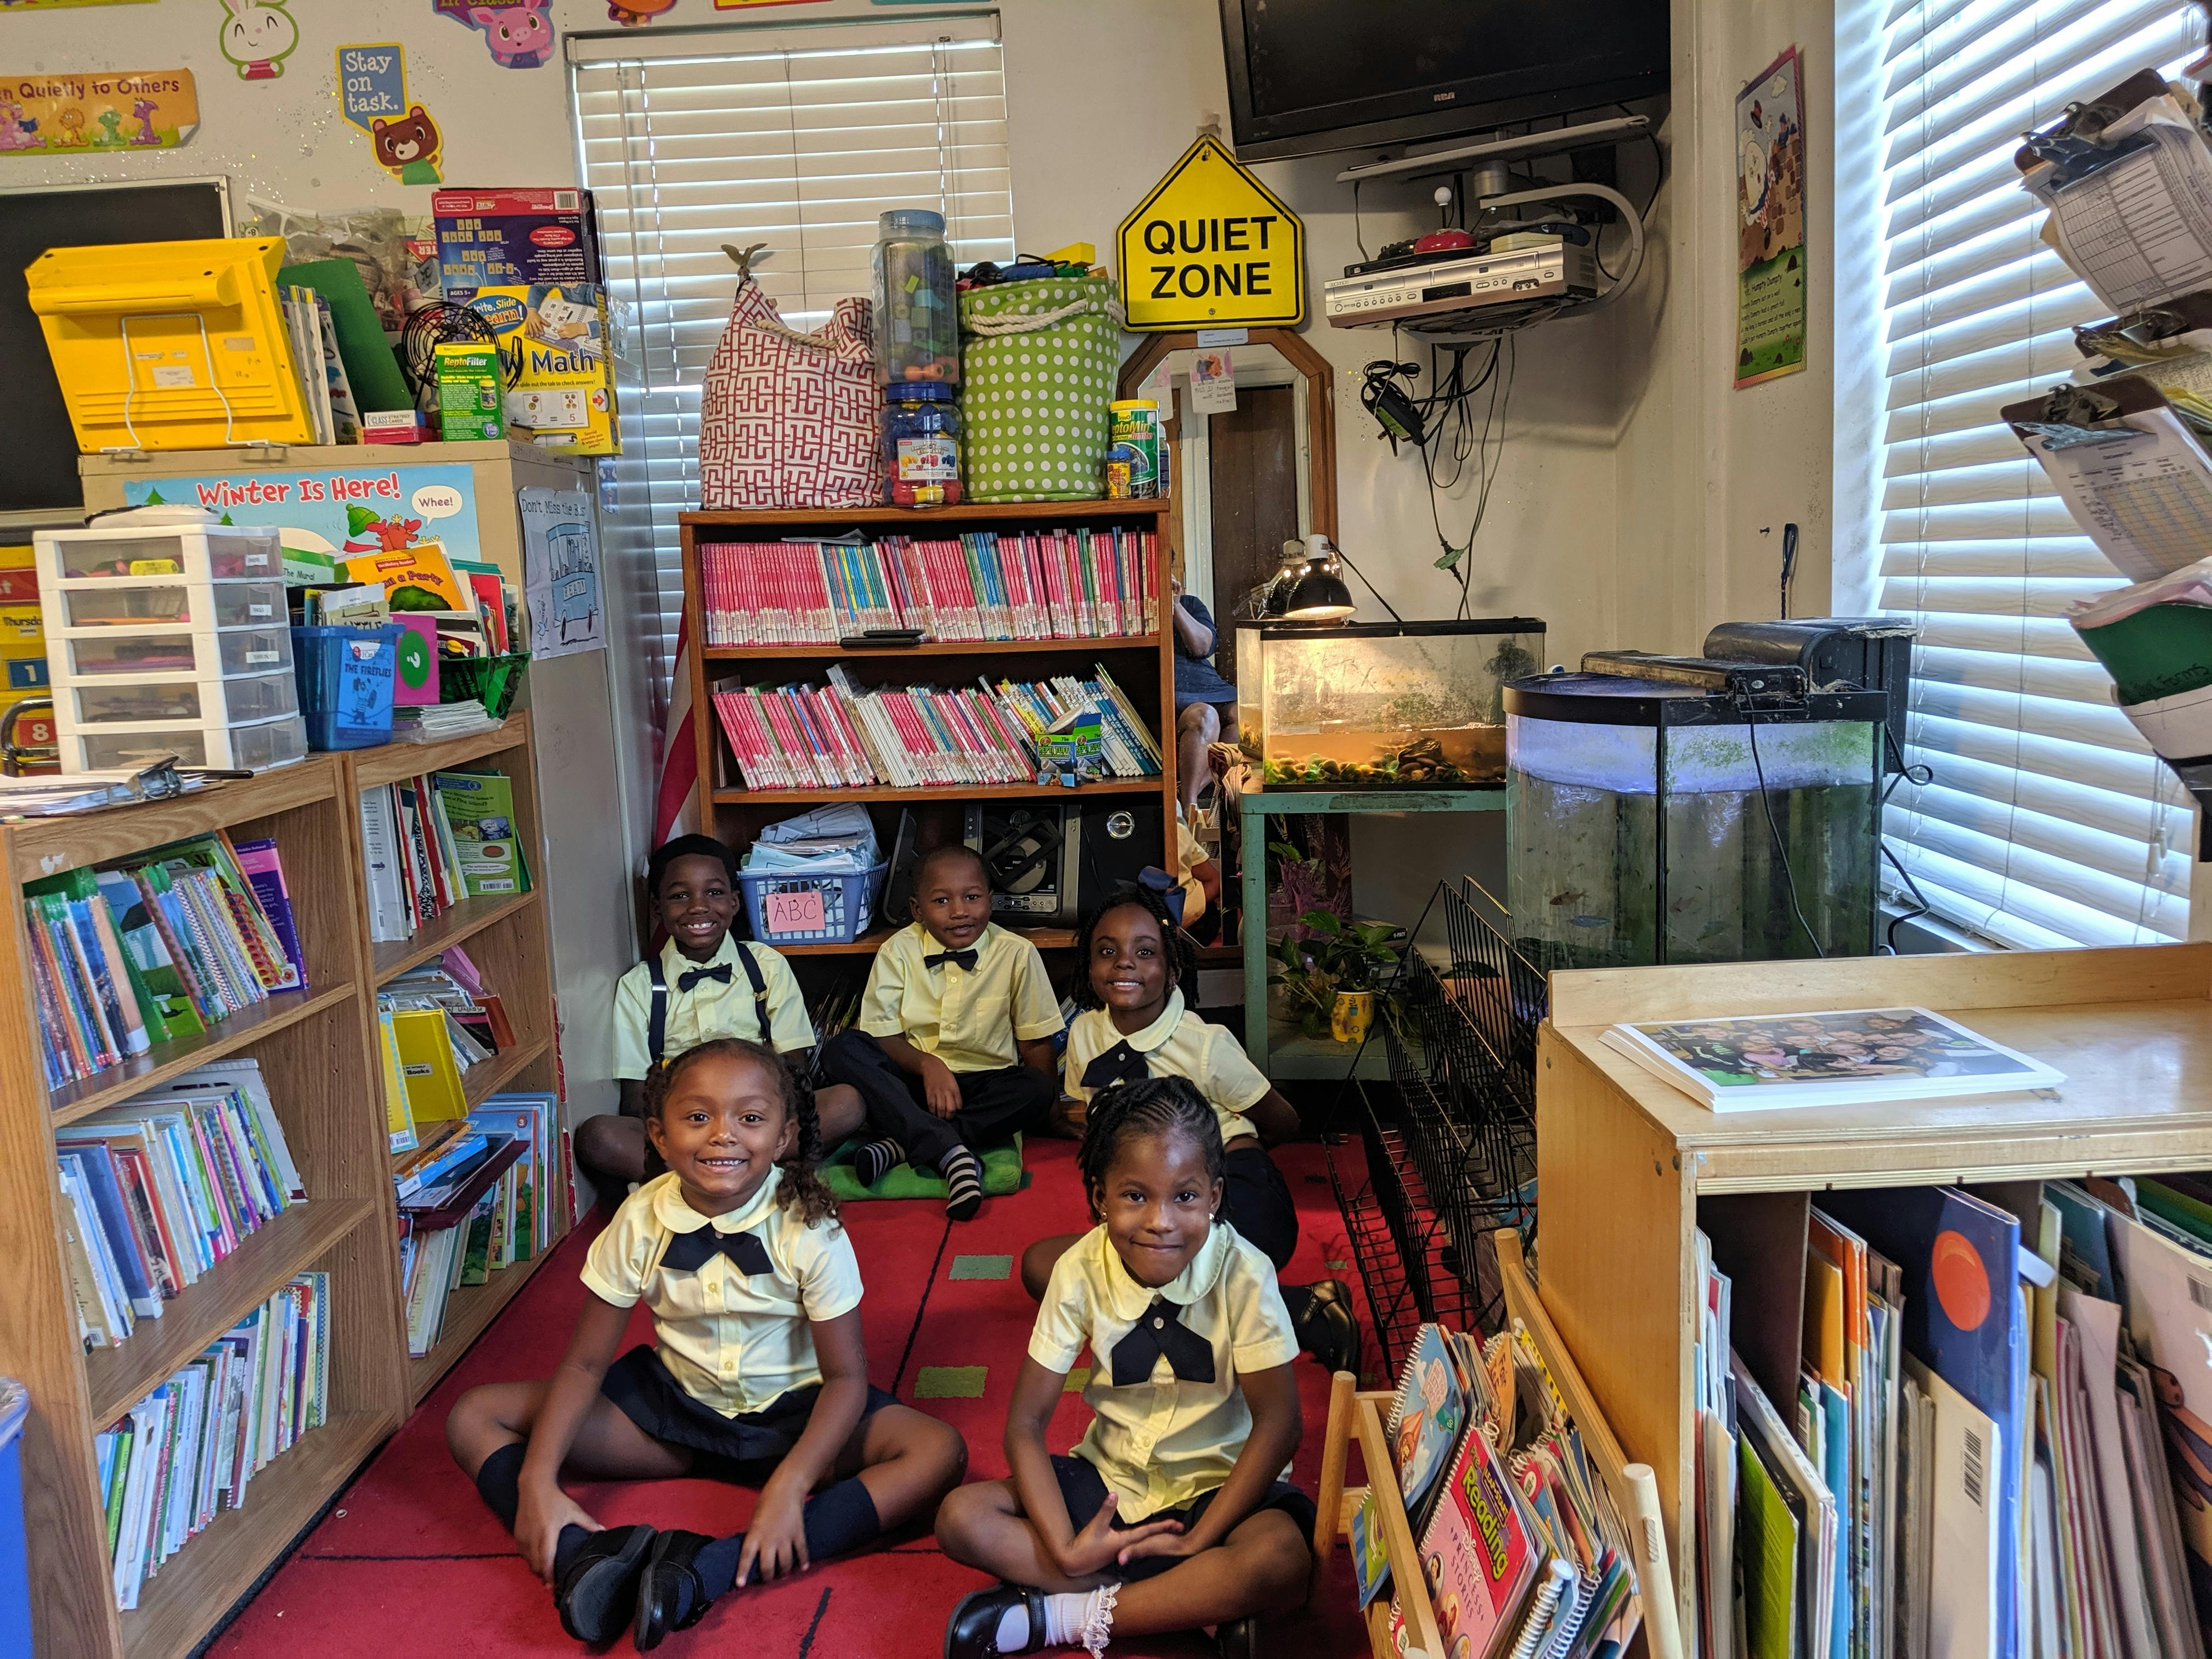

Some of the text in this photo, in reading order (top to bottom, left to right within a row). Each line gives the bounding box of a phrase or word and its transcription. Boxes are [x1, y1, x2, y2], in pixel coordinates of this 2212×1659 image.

[345, 51, 392, 74] Stay
[20, 81, 85, 100] Quietly
[92, 80, 110, 95] to
[117, 78, 180, 94] Others
[347, 75, 373, 93] on
[348, 92, 399, 113] task.
[1434, 92, 1455, 101] RCA
[1144, 216, 1278, 256] QUIET
[1150, 262, 1272, 299] ZONE
[496, 298, 516, 311] Slide
[483, 304, 524, 324] earn!
[444, 357, 488, 367] ReptoFilter
[531, 347, 594, 375] Math
[531, 414, 575, 424] 2 5
[1112, 420, 1150, 436] eptoMin
[196, 472, 401, 506] Winter Is Here!
[419, 496, 454, 508] Whee!
[522, 499, 541, 514] Don't
[545, 500, 561, 515] Miss
[562, 502, 572, 514] the
[283, 568, 315, 580] The Mural
[398, 570, 444, 588] a Party
[563, 579, 585, 598] READ!
[22, 665, 38, 682] 1
[345, 663, 392, 678] THE FIREFLIES
[32, 723, 49, 741] 8
[1089, 743, 1100, 751] TUFF
[774, 898, 819, 922] ABC
[1462, 1466, 1509, 1582] Reading
[1452, 1530, 1483, 1614] PRINCESS
[1451, 1555, 1475, 1619] STORIES
